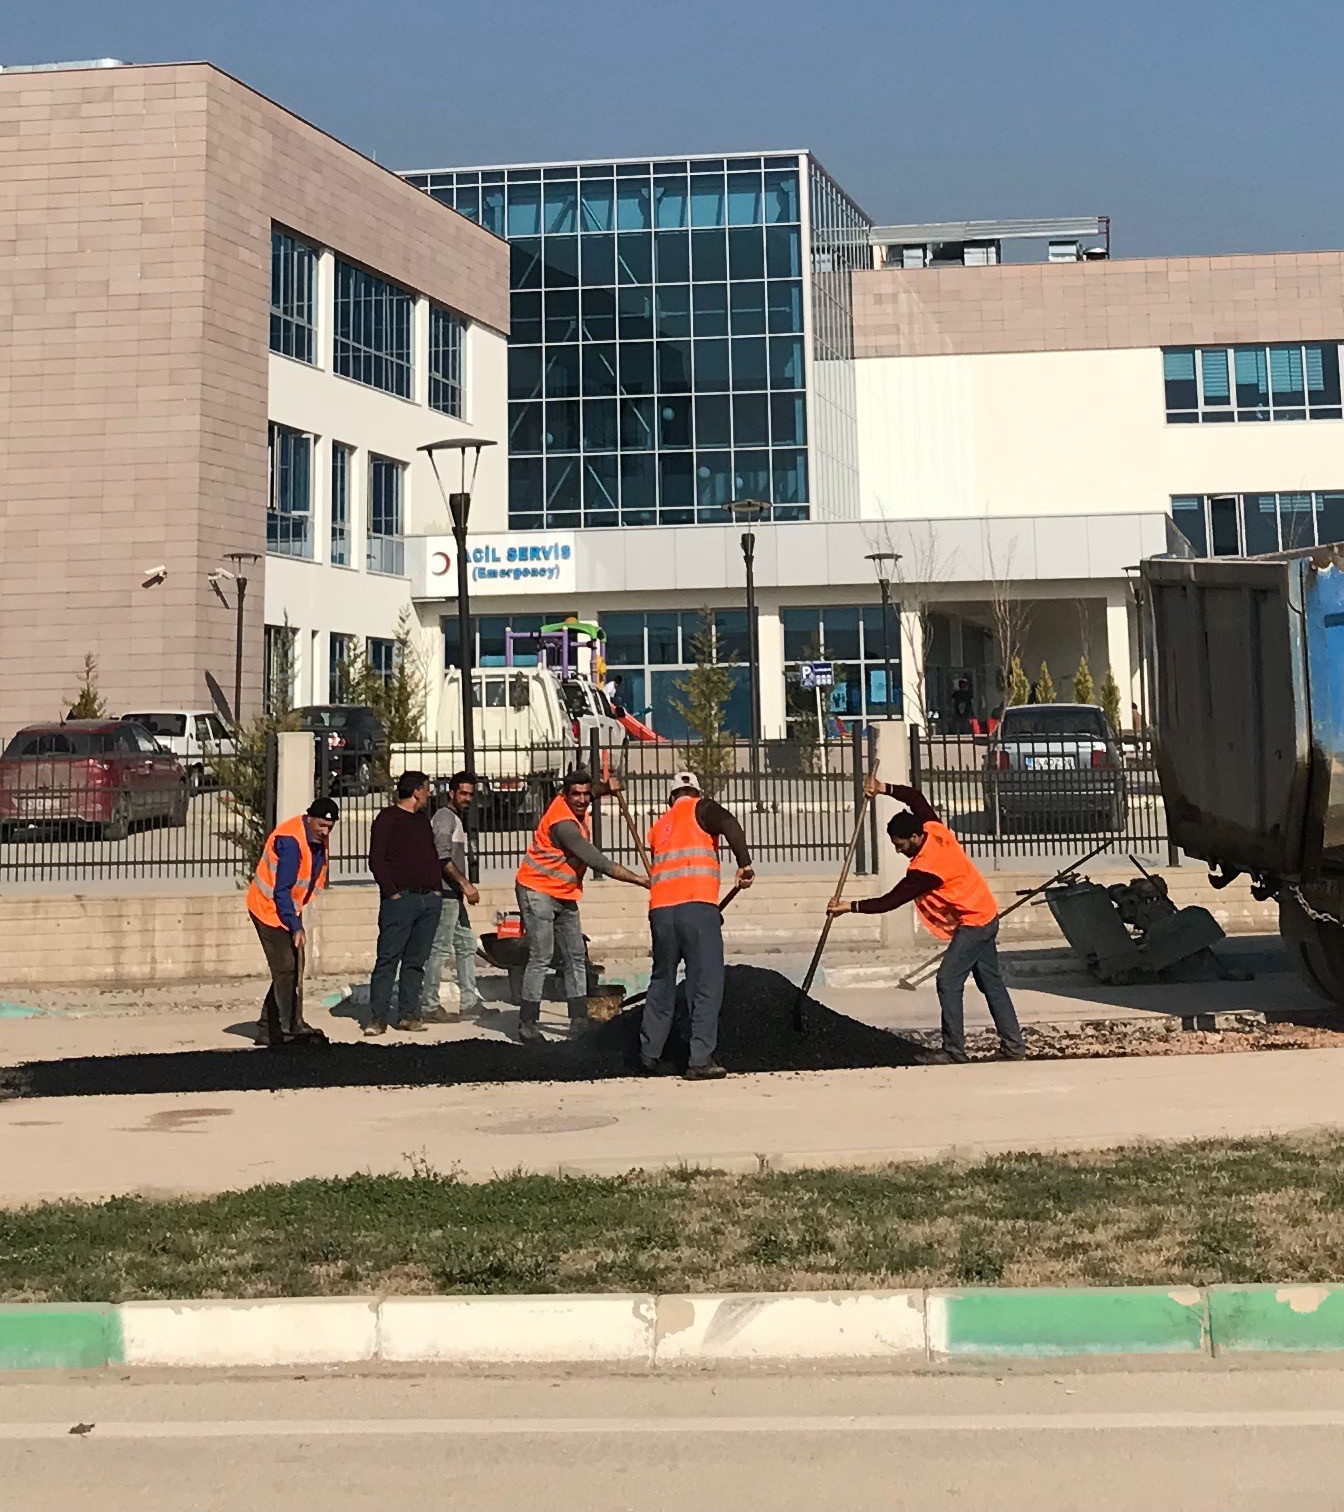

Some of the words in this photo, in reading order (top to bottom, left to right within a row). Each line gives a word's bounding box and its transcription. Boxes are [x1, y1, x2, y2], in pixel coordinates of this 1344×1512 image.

[506, 542, 571, 562] SERVİS
[472, 564, 560, 582] (Emergency)
[802, 666, 812, 680] P
